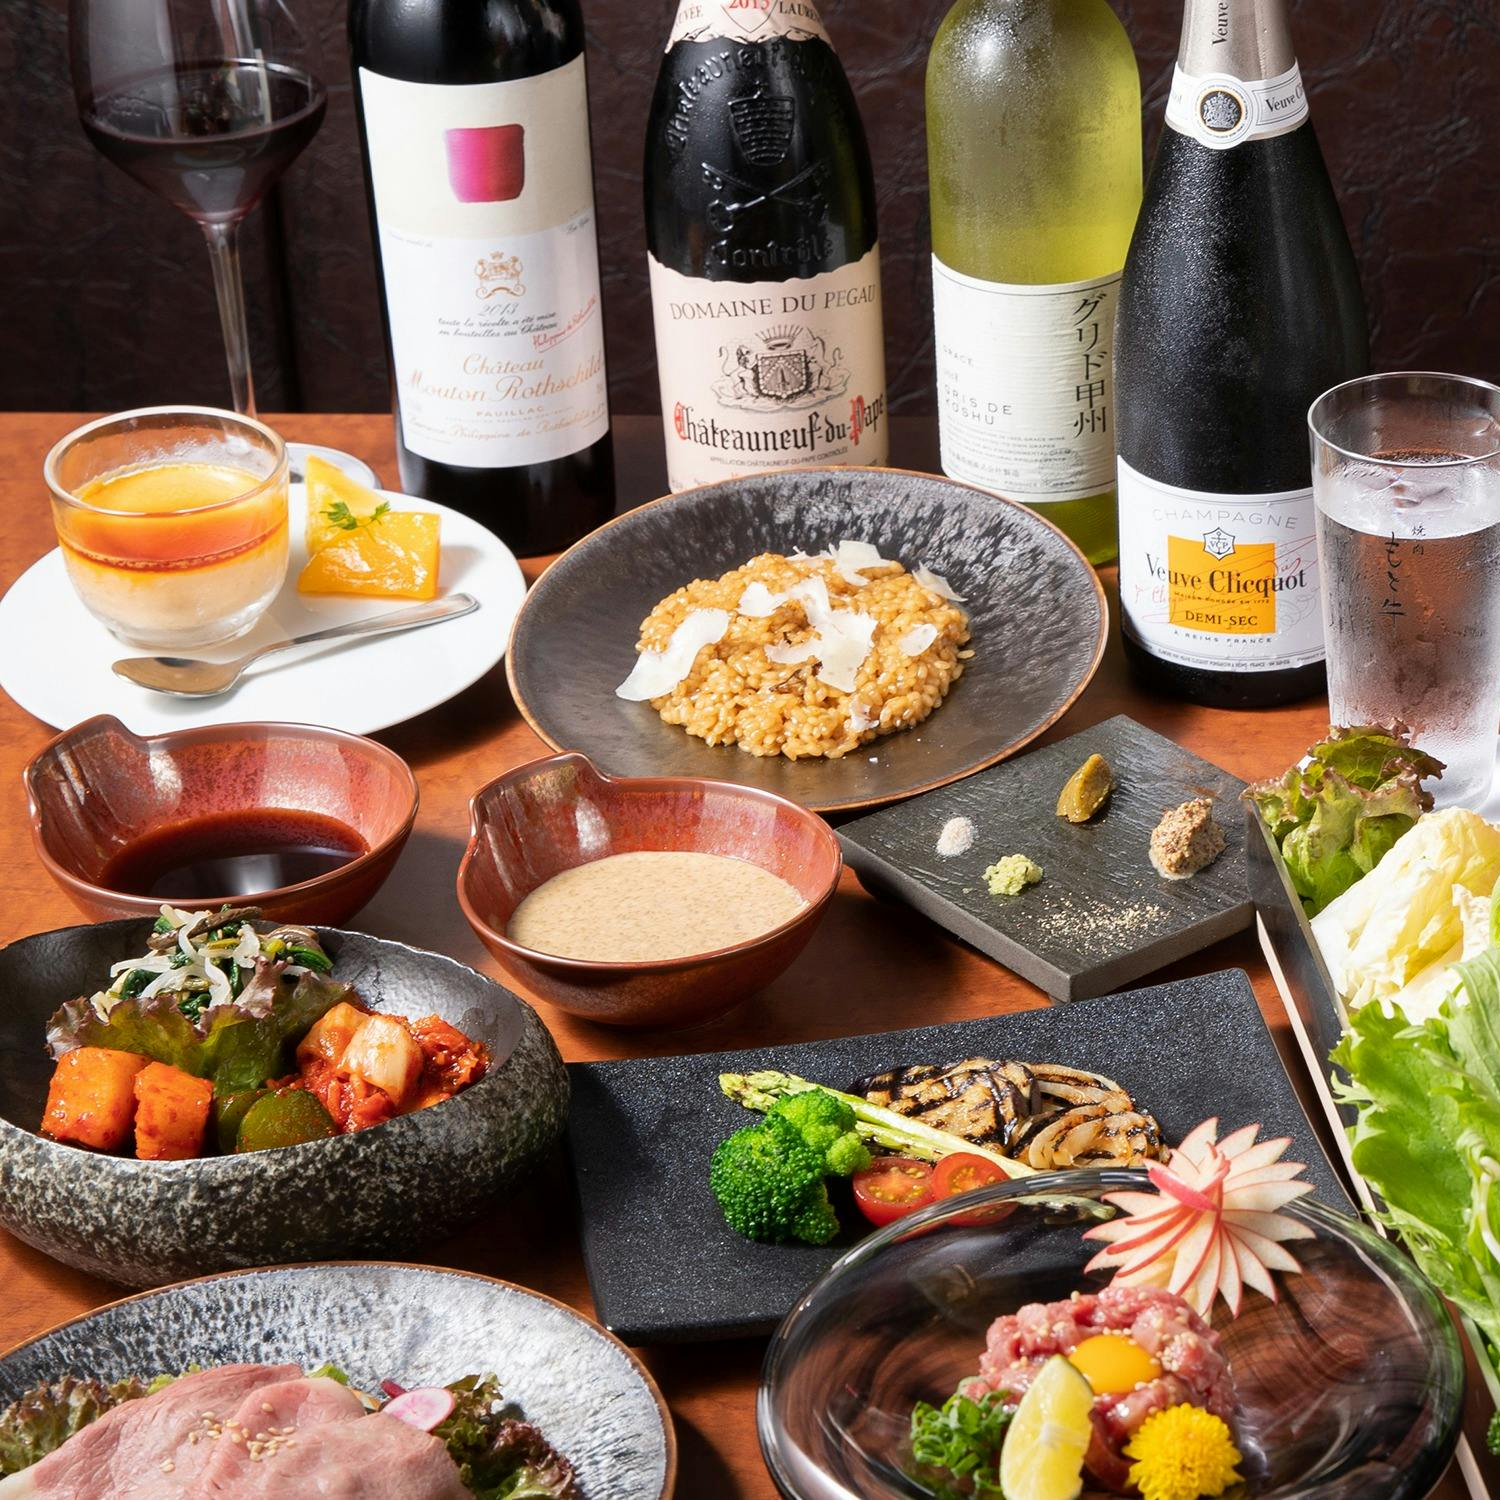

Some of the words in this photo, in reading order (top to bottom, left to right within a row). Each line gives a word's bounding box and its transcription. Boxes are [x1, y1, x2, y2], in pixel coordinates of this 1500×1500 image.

[1212, 2, 1228, 45] Veuve
[1265, 92, 1295, 113] Veuve
[670, 299, 773, 321] DOMAINE
[782, 294, 817, 314] DU
[462, 352, 545, 376] Château
[1072, 292, 1108, 439] グリド甲州
[400, 369, 486, 401] Mouton
[495, 353, 602, 402] Rothschild
[987, 402, 1013, 416] DE
[1151, 507, 1299, 530] CHAMPAGNE
[1145, 551, 1201, 590] Veuve
[1209, 567, 1308, 598] Clicquot
[1184, 609, 1259, 626] DEMI-SEC
[1184, 631, 1220, 643] REIMS
[1226, 636, 1273, 644] FRANCE
